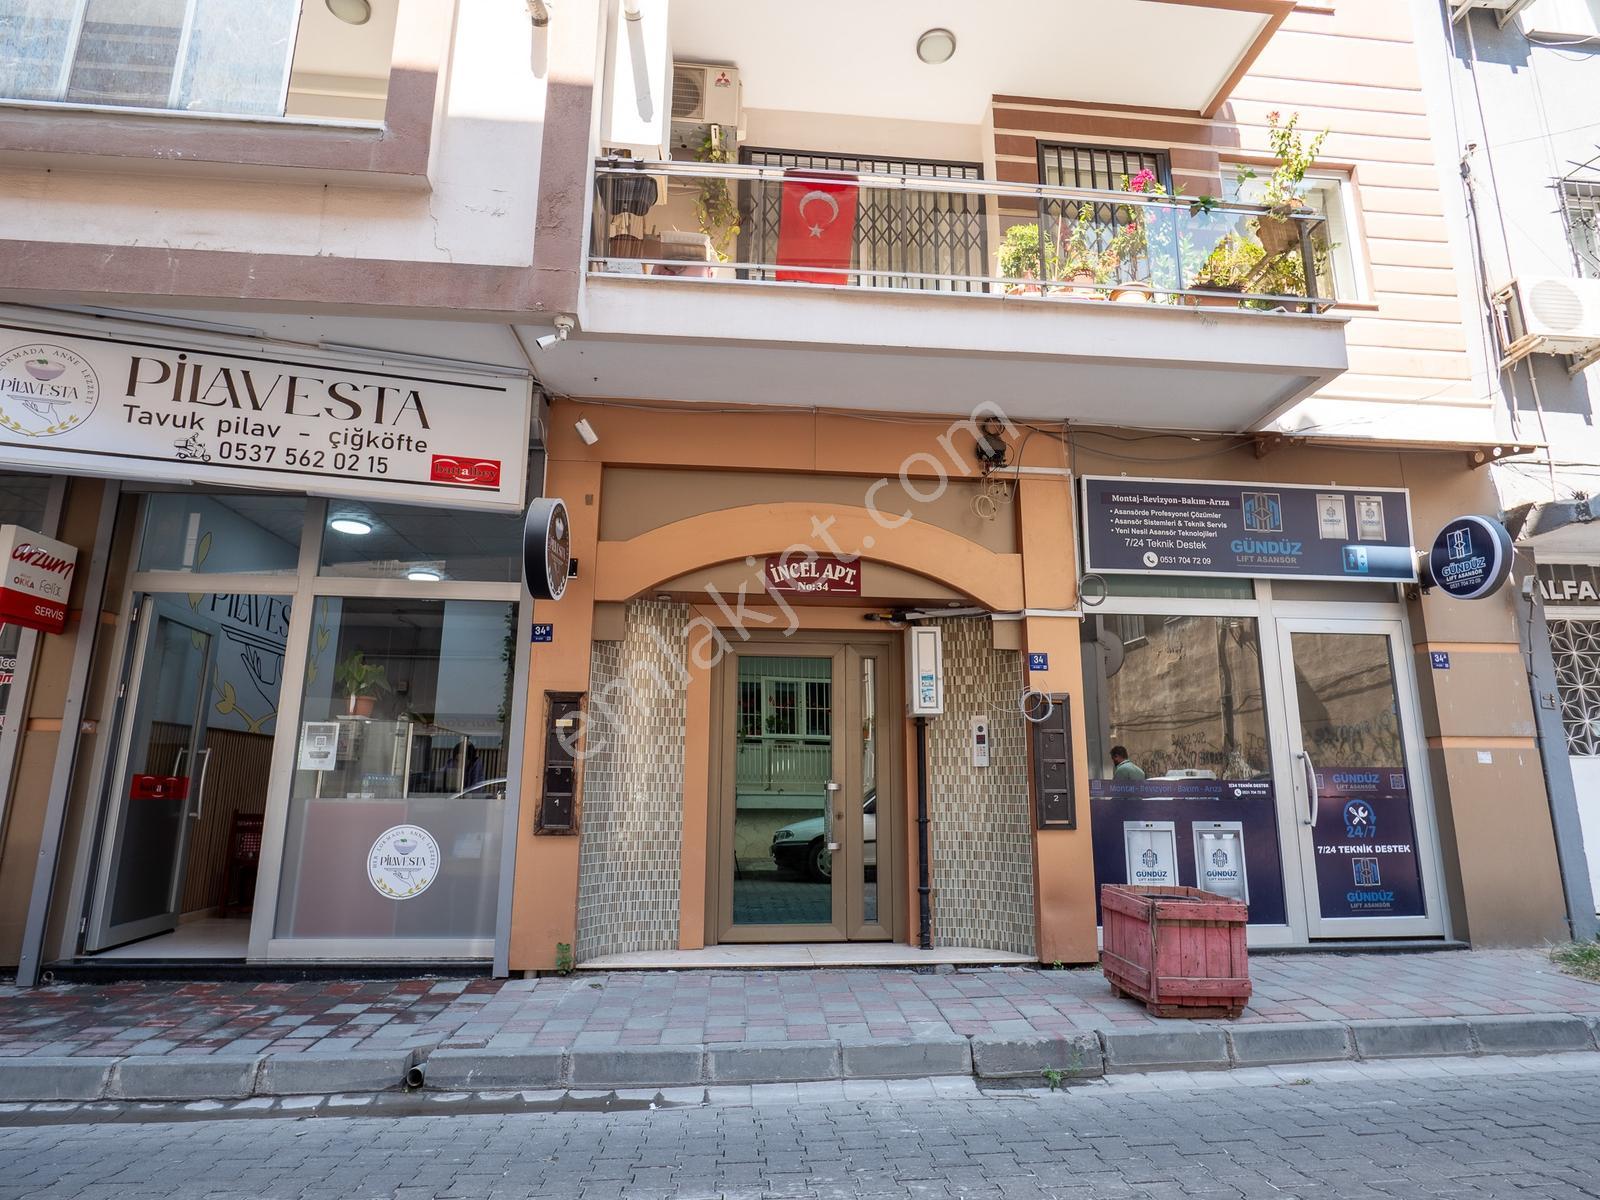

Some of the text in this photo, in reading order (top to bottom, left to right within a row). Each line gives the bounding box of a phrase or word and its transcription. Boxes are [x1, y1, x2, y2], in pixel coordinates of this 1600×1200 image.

[53, 350, 80, 366] ANNE
[0, 377, 79, 399] PİLAVESTA
[126, 353, 431, 430] PİLAVESTA
[122, 404, 205, 431] Tavuk
[217, 416, 281, 437] pilav
[328, 427, 428, 453] çiğköfte
[218, 441, 388, 474] 0537 562 02 15
[1151, 510, 1190, 518] Profesyonel
[1191, 511, 1222, 519] Çözümler
[1125, 538, 1207, 549] 7/24 Teknik Destek
[1230, 537, 1303, 555] GÜNDÜZ
[12, 543, 74, 580] arzum
[1160, 556, 1177, 564] 0531
[1202, 557, 1212, 565] 09
[1442, 556, 1486, 577] GÜNDÜZ
[769, 562, 857, 585] İNCEL APT.
[14, 576, 35, 589] OKKA
[797, 581, 829, 591] No:34
[34, 604, 64, 621] SERVİS
[535, 626, 546, 635] 34
[1033, 655, 1044, 664] 34
[1434, 654, 1444, 663] 34
[1333, 772, 1380, 783] GÜNDÜZ
[1053, 794, 1060, 802] 2
[1346, 826, 1376, 838] 24/7
[1317, 844, 1411, 854] 7/24 TEKNİK DESTEK
[1136, 870, 1168, 878] GÜNDÜZ
[1347, 890, 1394, 901] GÜNDÜZ
